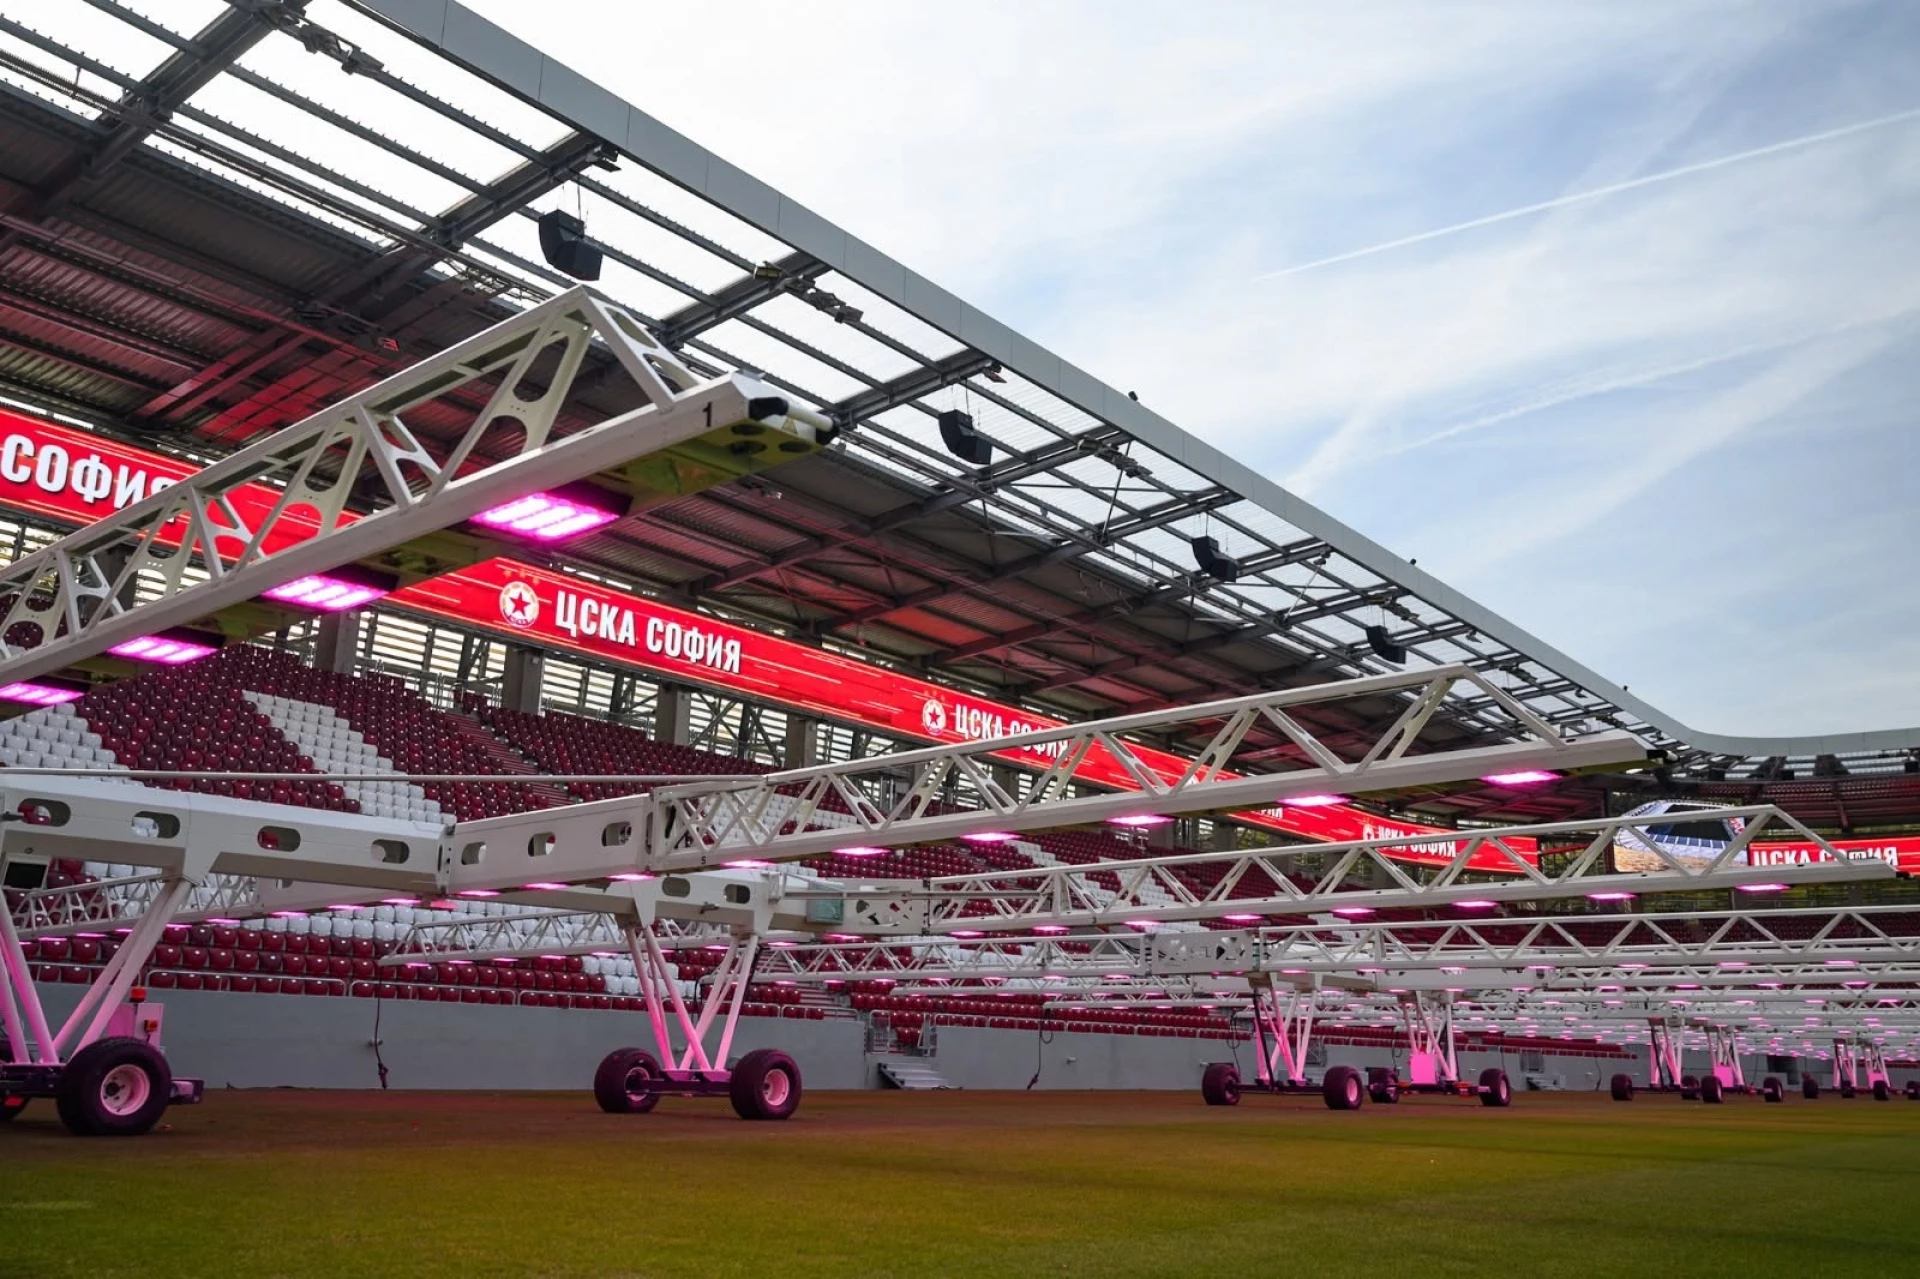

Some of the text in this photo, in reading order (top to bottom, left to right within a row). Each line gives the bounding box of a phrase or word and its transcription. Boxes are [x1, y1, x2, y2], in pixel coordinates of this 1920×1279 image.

[702, 402, 712, 427] 1
[555, 590, 741, 674] ЦСКА СОФИЯ
[955, 703, 1004, 740] ЦСКА
